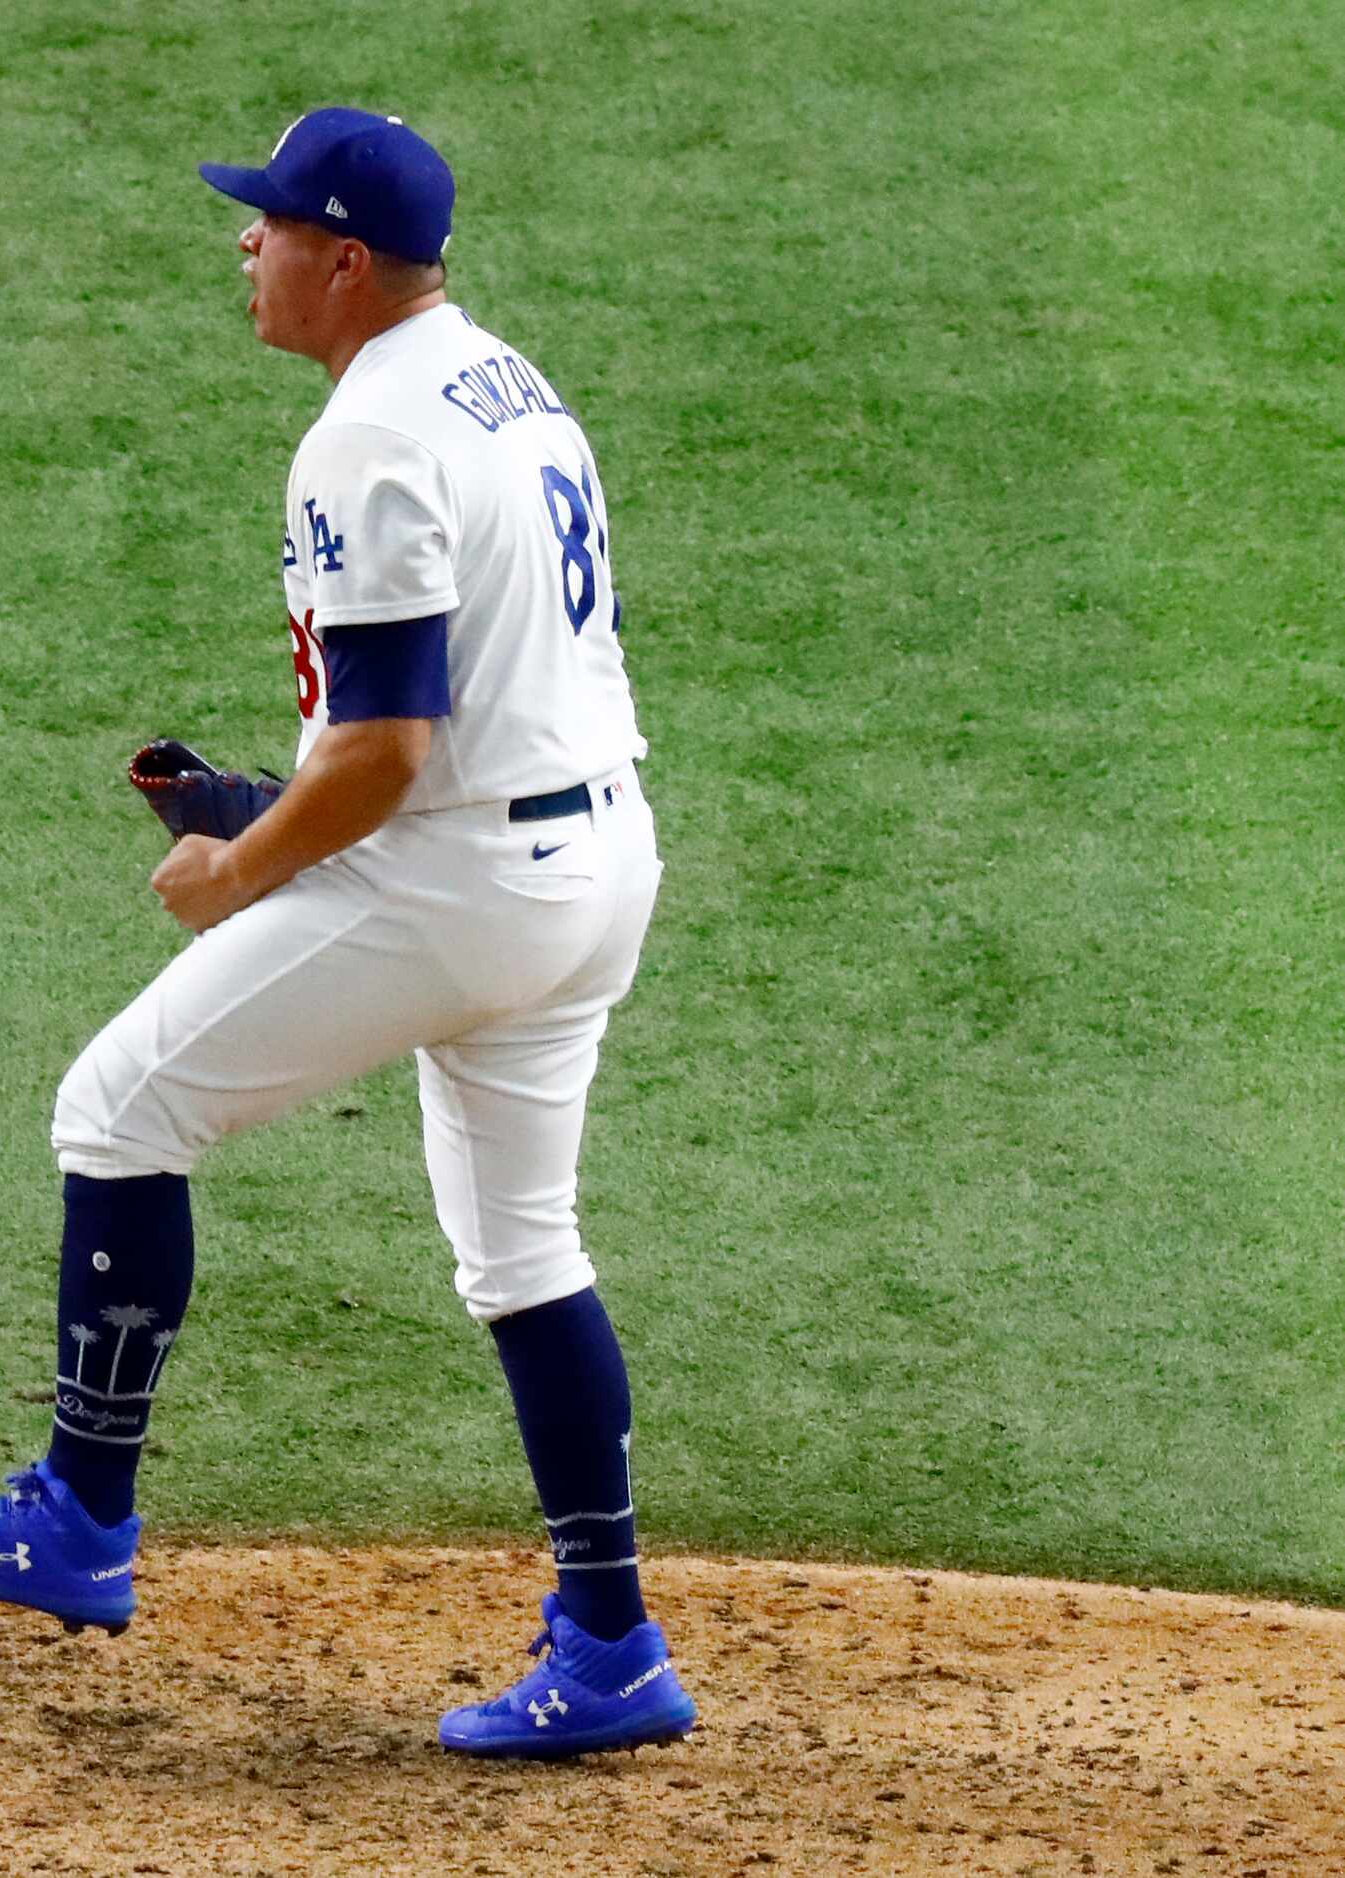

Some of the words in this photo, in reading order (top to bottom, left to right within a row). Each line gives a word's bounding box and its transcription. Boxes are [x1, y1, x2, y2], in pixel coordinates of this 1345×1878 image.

[441, 342, 570, 433] GONZÁL
[305, 498, 344, 577] LA
[289, 612, 333, 719] 8
[56, 1394, 139, 1431] Dodgers
[618, 1664, 663, 1699] UNDER
